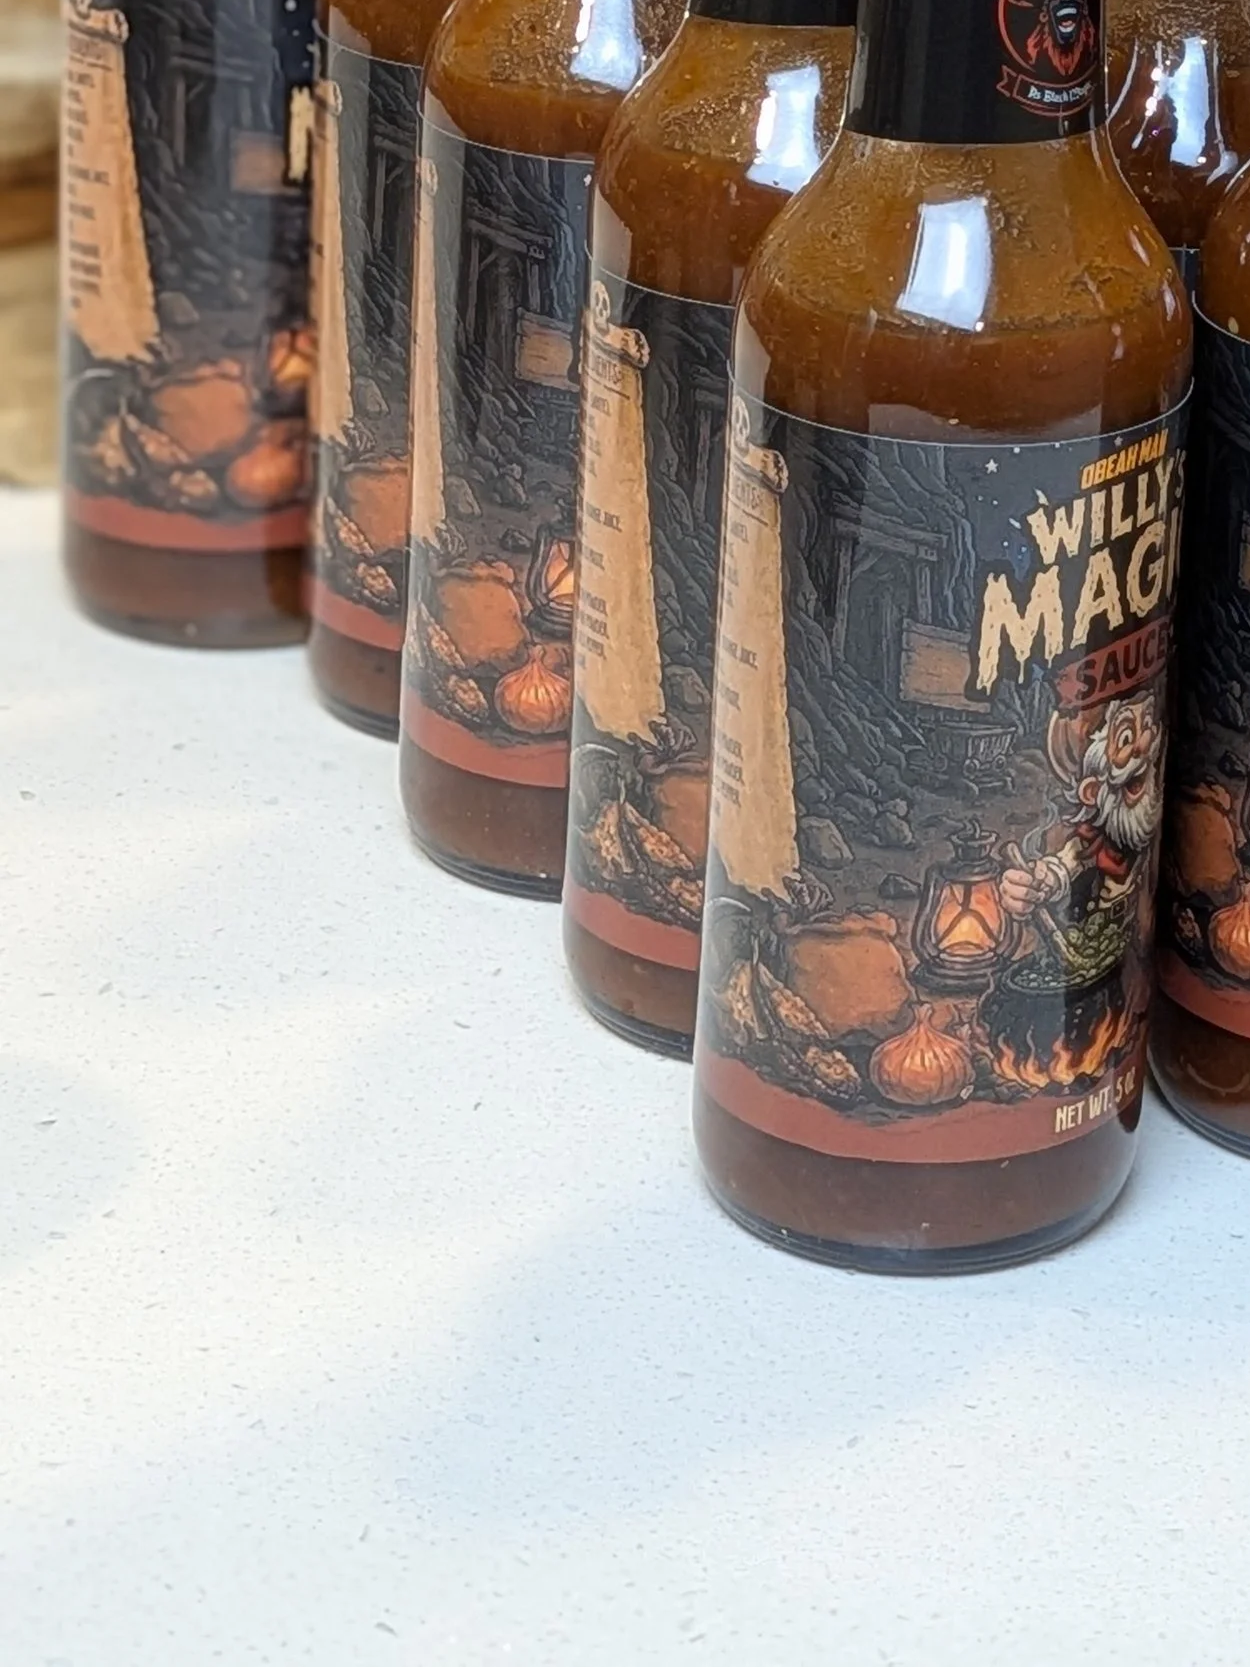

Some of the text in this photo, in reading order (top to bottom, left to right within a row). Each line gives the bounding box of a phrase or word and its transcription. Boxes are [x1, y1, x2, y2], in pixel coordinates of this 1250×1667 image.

[1081, 428, 1169, 490] OBEAH MAN
[1055, 1100, 1086, 1134] NET
[1088, 1085, 1113, 1120] WT.
[1115, 1076, 1125, 1104] 5
